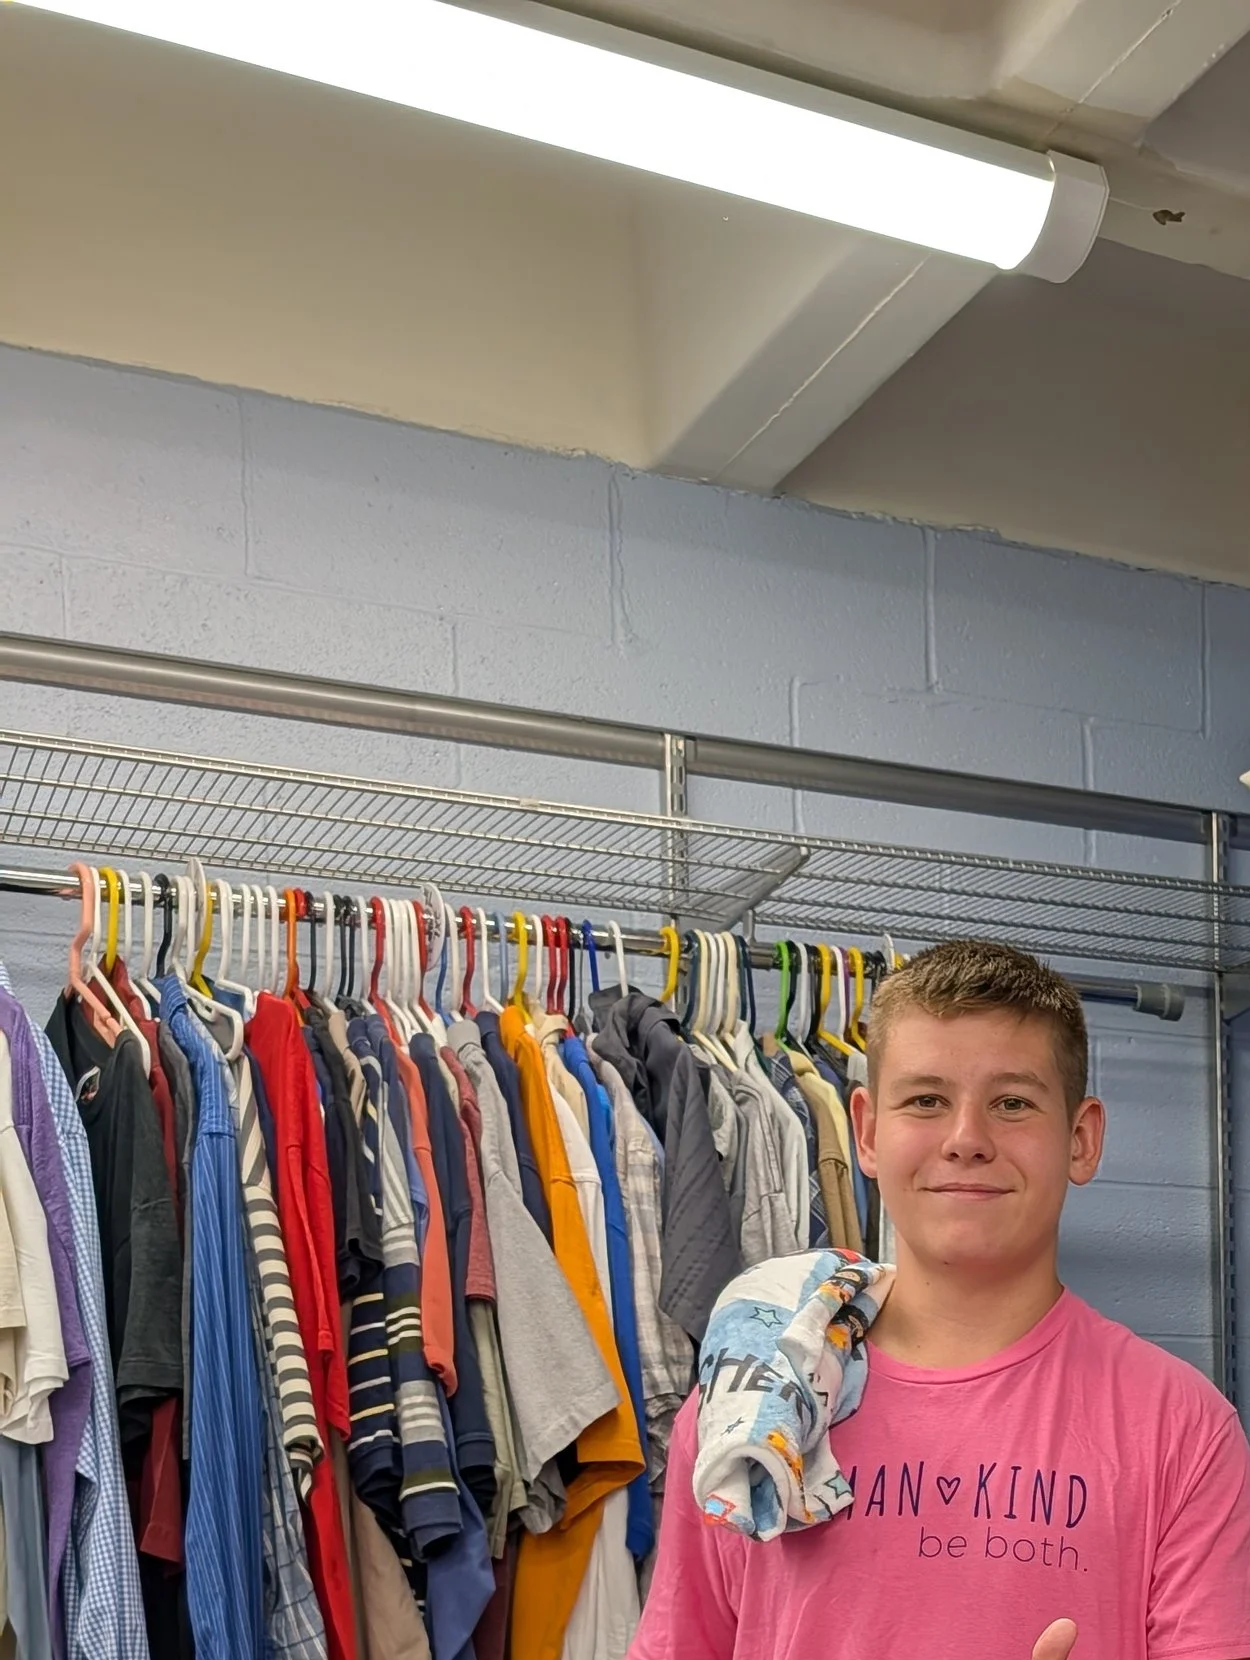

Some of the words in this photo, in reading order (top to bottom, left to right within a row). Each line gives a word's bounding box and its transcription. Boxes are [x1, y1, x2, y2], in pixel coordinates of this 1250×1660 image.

[973, 1462, 1087, 1529] KIND
[918, 1526, 967, 1558] be
[985, 1527, 1088, 1572] both.
